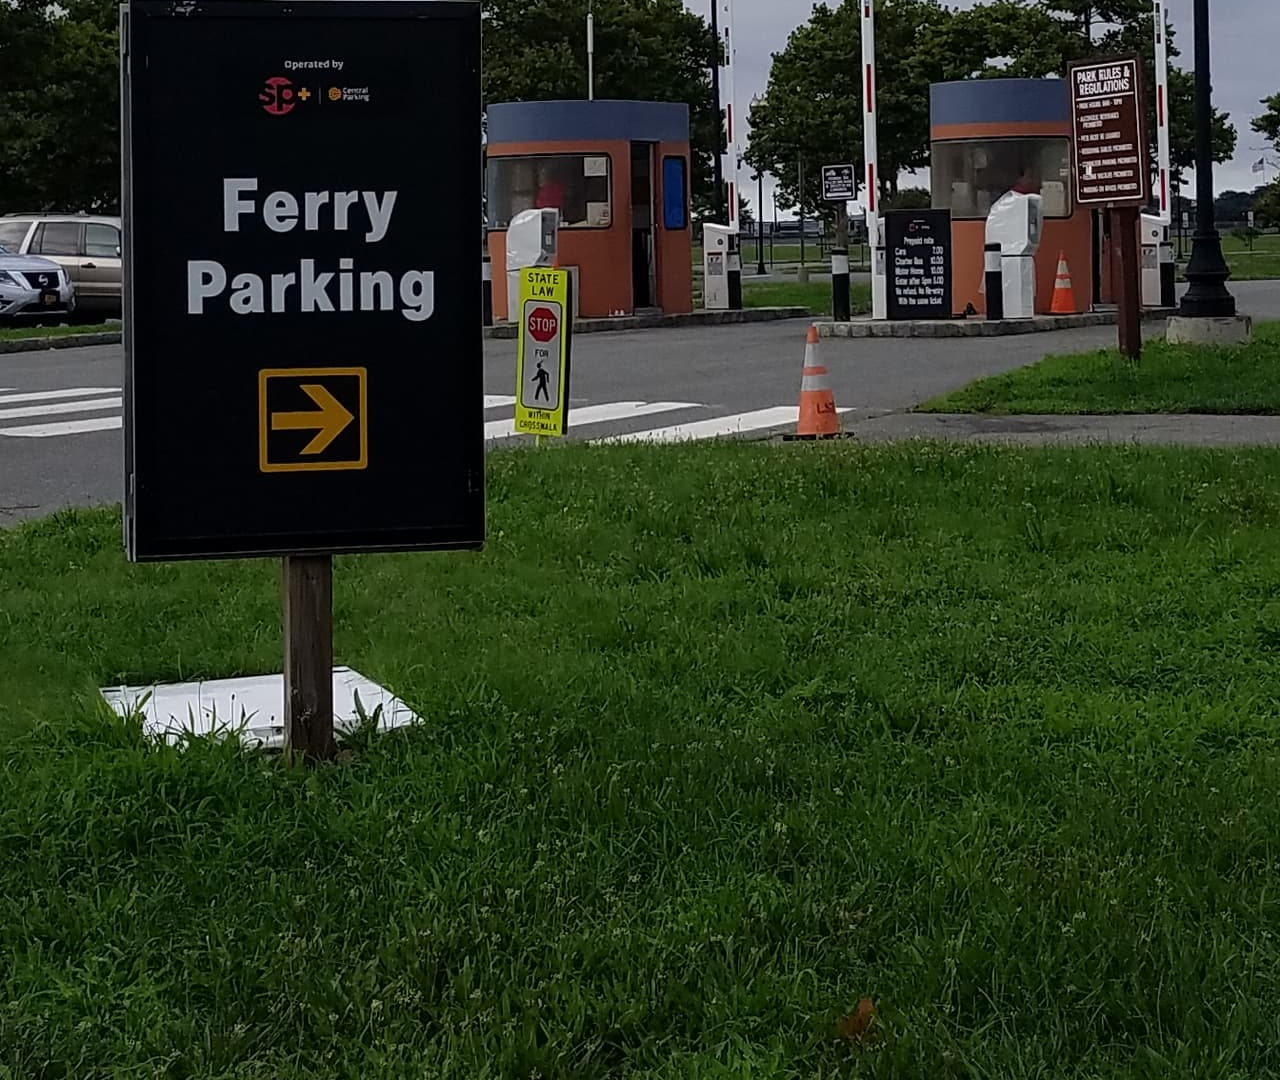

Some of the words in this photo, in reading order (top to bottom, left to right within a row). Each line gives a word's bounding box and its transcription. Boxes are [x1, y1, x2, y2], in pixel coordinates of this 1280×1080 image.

[284, 60, 329, 71] Operated
[332, 59, 344, 71] by
[1077, 70, 1097, 84] PARK
[1098, 66, 1122, 80] RULES
[1123, 65, 1131, 78] &
[1079, 78, 1130, 96] REGULATIONS
[343, 94, 370, 102] Parking
[223, 177, 398, 243] Ferry
[527, 272, 560, 285] STATE
[187, 257, 434, 322] Parking
[531, 286, 554, 297] LAW
[529, 317, 556, 333] STOP
[535, 348, 549, 358] FOR
